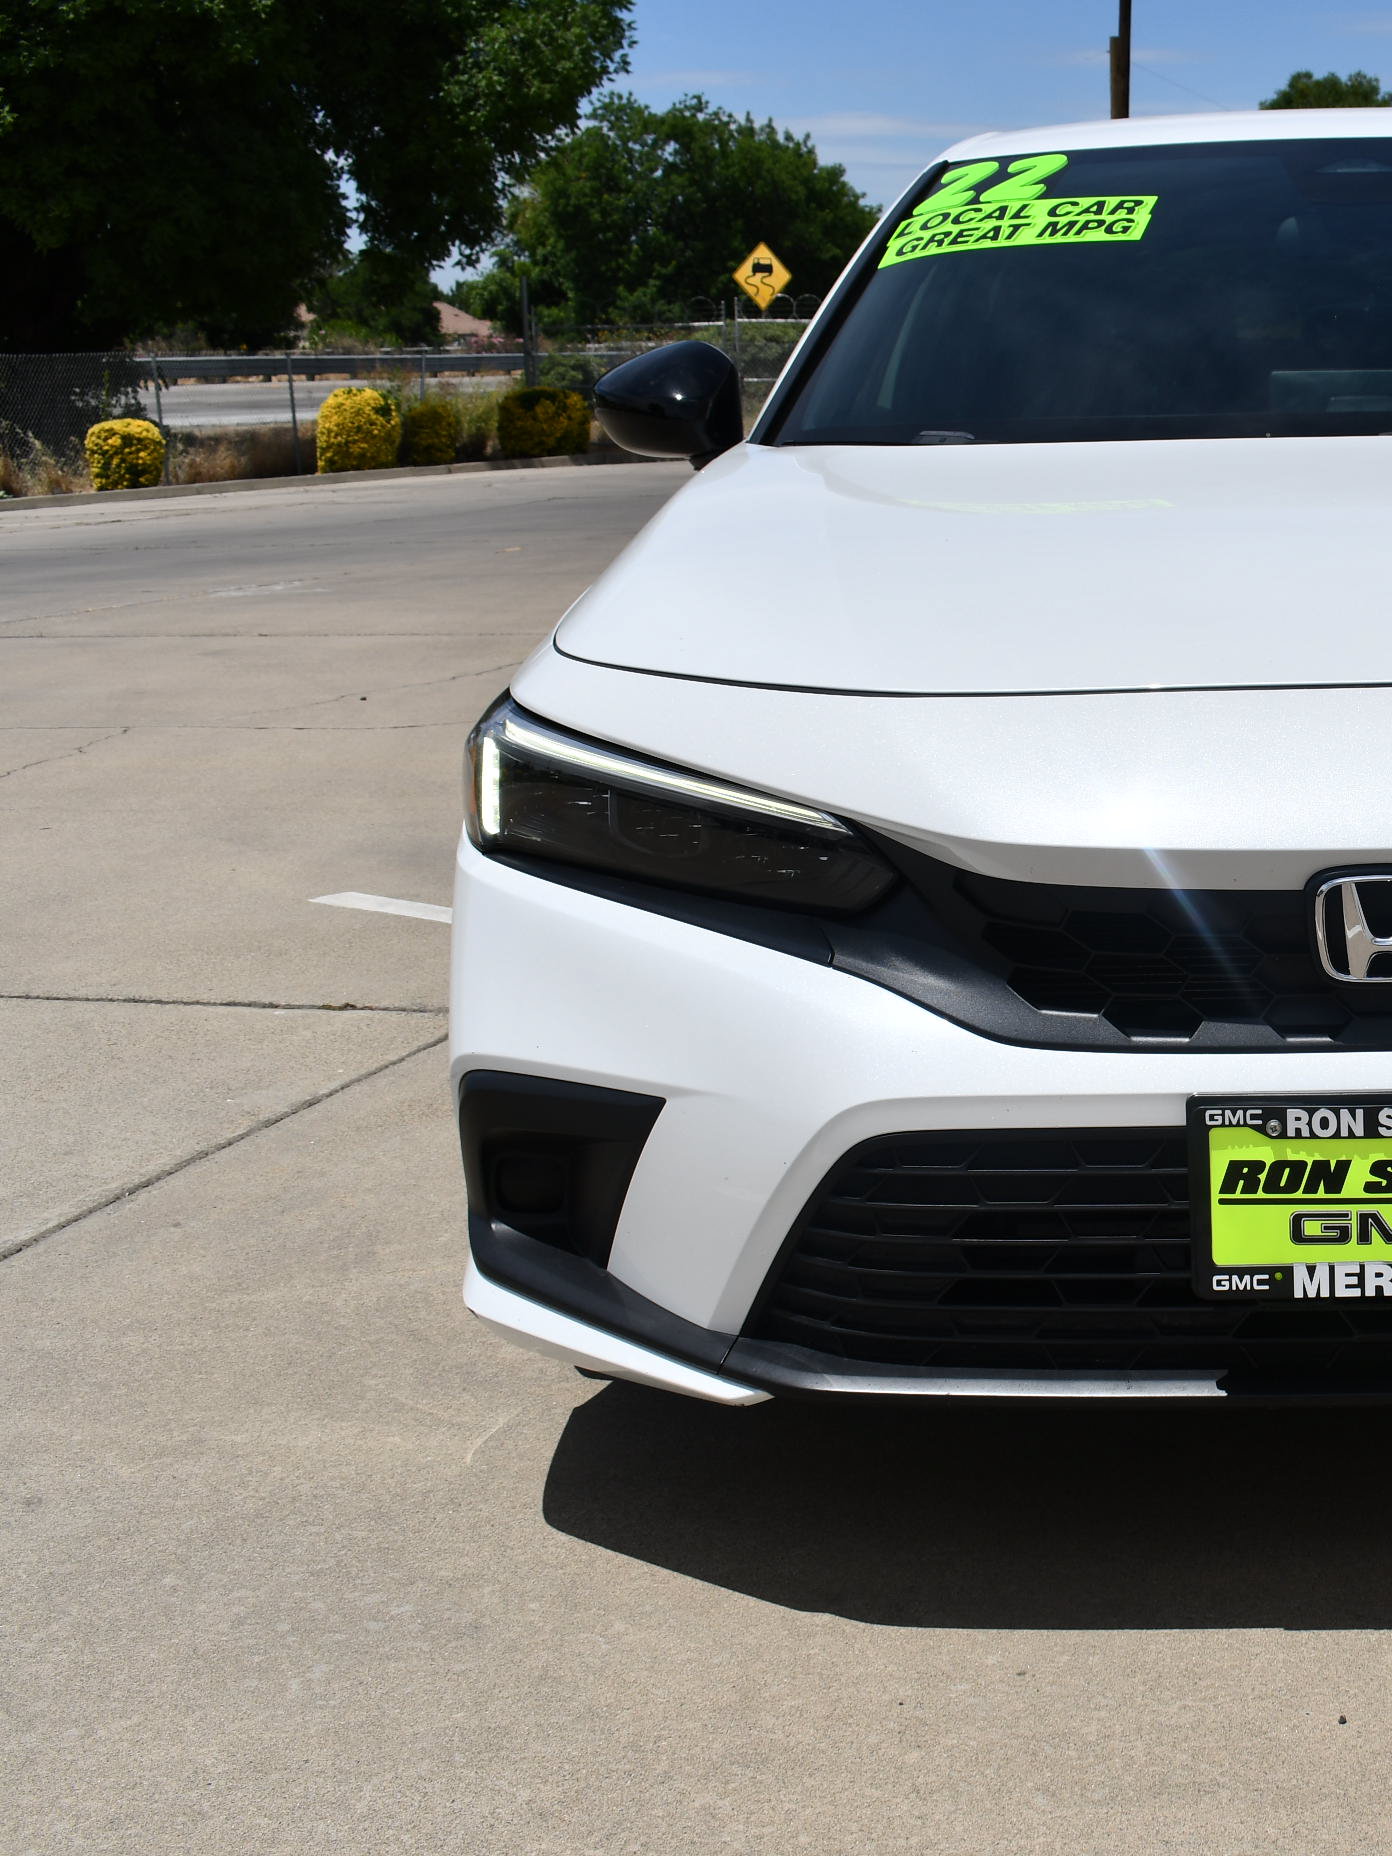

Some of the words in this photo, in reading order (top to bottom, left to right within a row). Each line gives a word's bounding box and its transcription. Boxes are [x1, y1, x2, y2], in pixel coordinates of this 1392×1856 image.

[912, 154, 1068, 216] 22
[894, 204, 1032, 240] LOCAL
[1046, 200, 1144, 218] CAR
[896, 222, 1032, 256] GREAT
[1036, 218, 1136, 238] MPG
[1205, 1109, 1262, 1126] GMC
[1286, 1108, 1365, 1138] RON
[1219, 1159, 1353, 1195] RON
[1212, 1274, 1270, 1292] GMC
